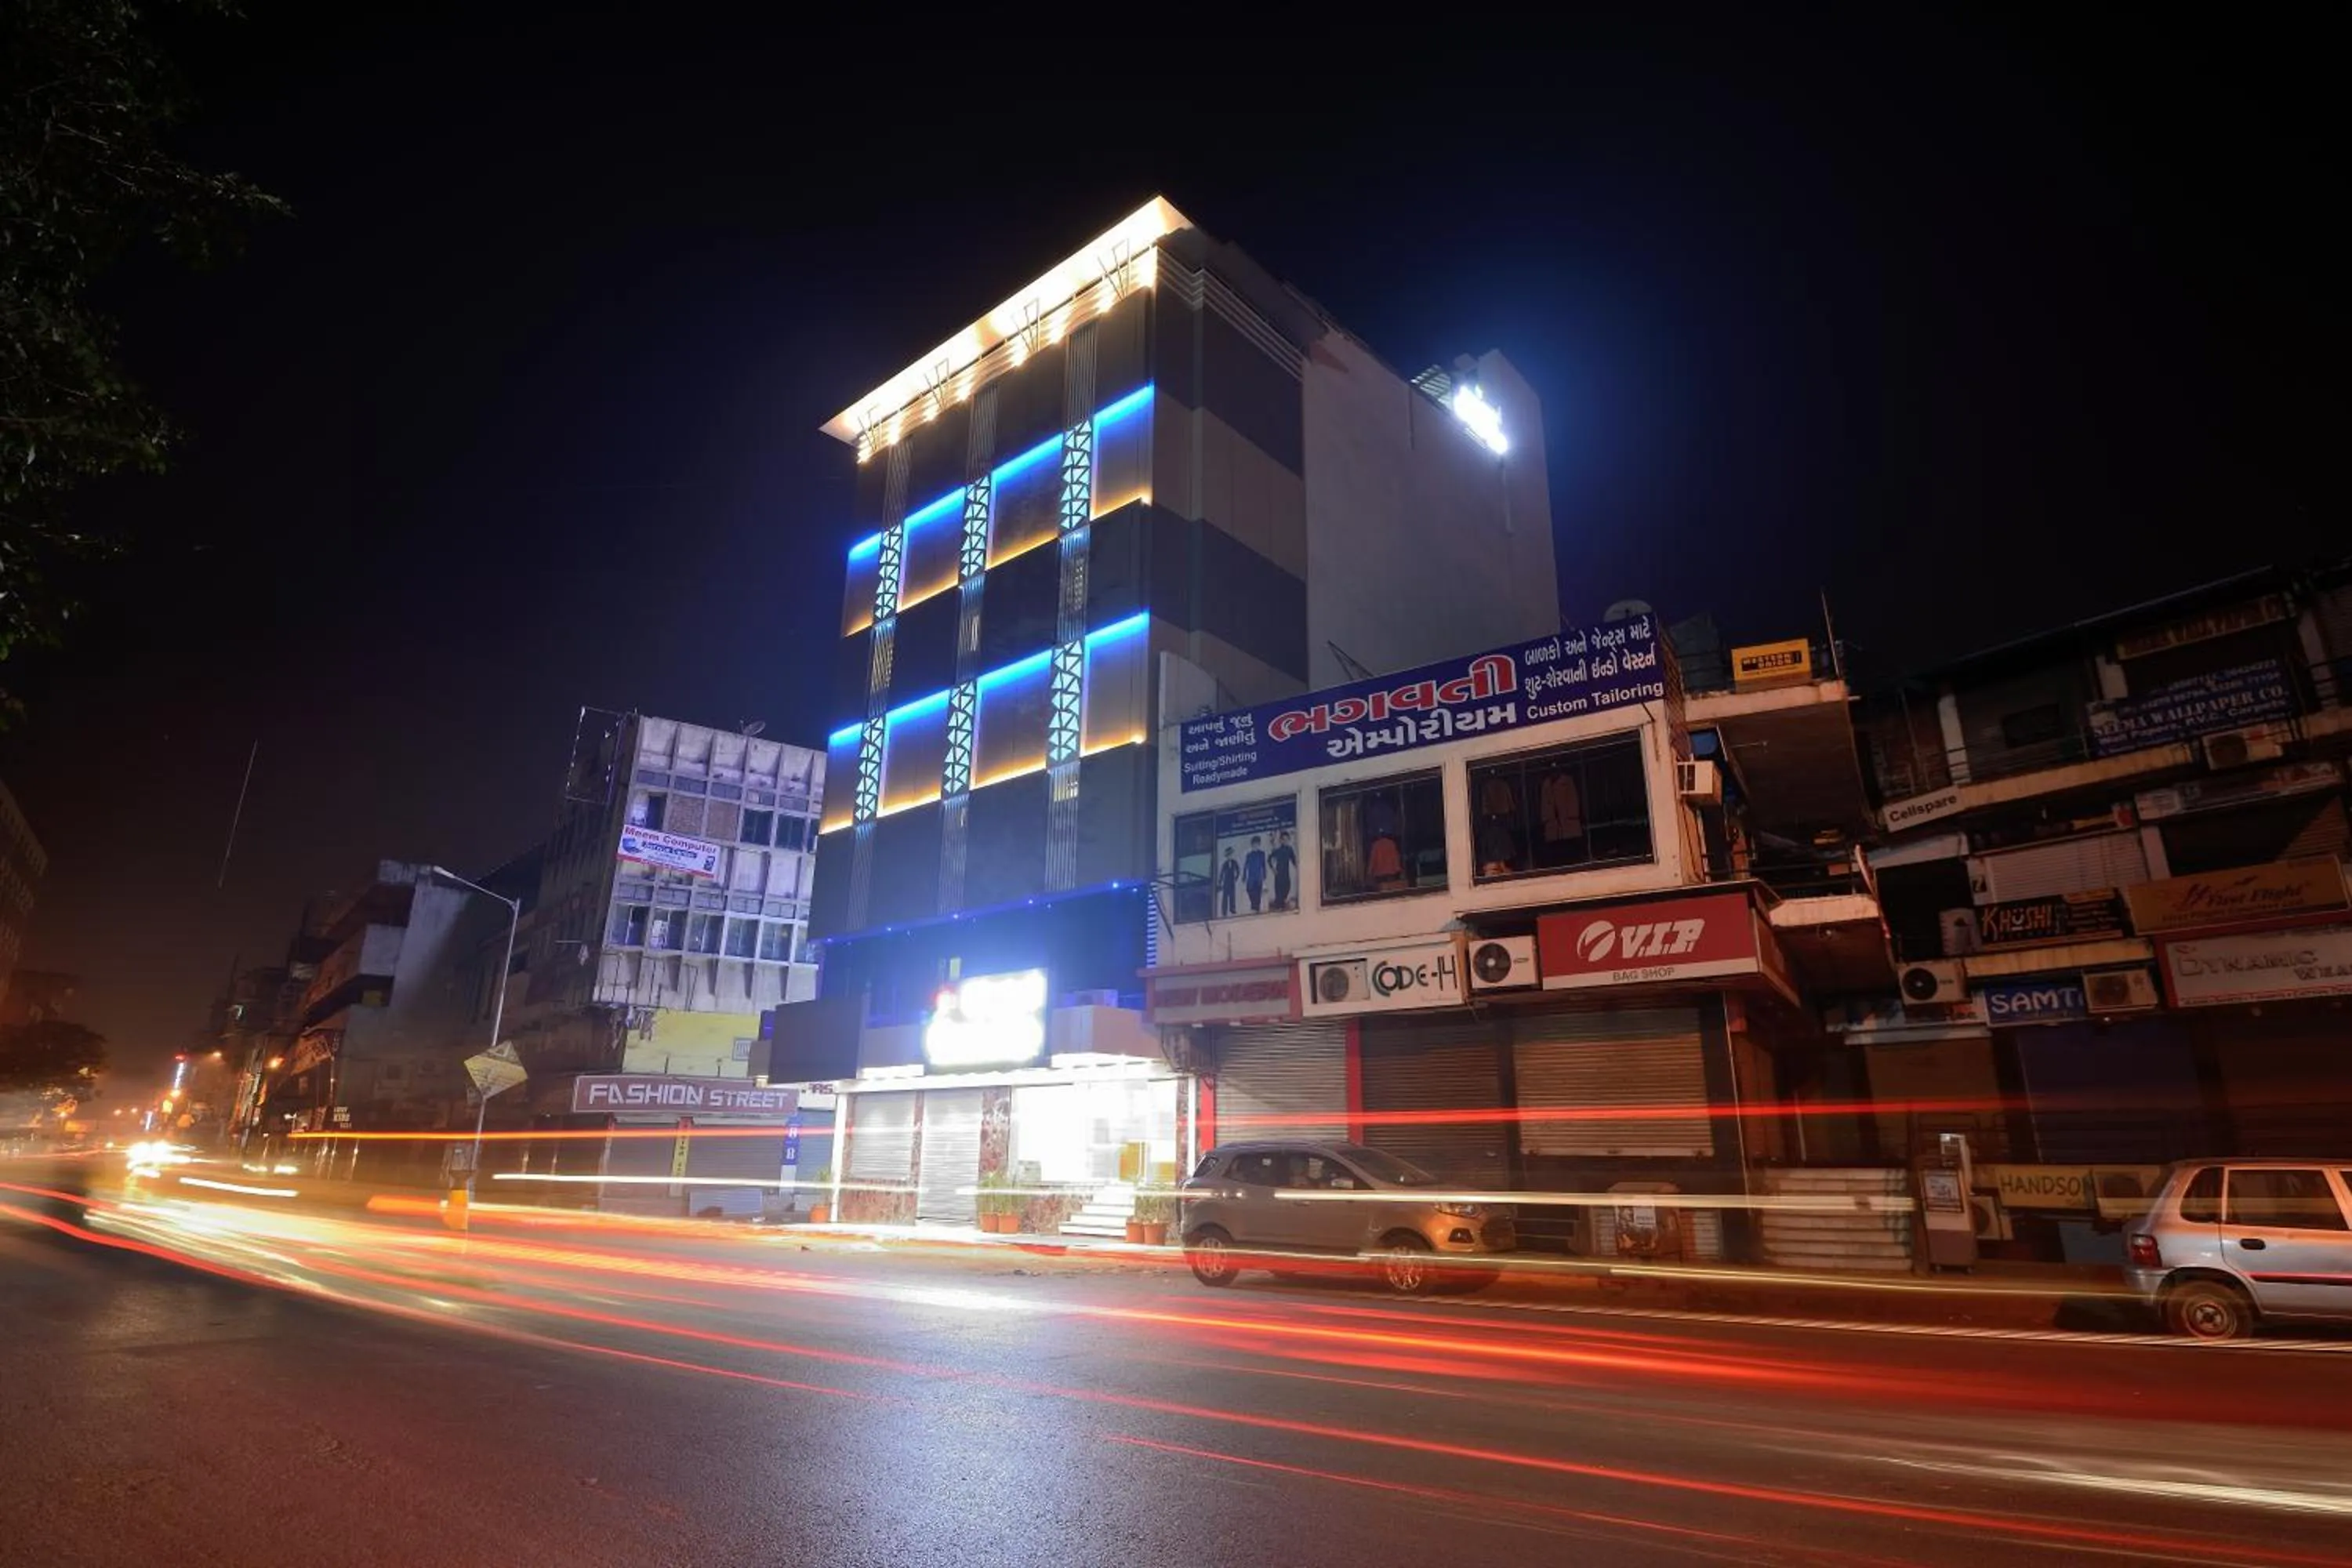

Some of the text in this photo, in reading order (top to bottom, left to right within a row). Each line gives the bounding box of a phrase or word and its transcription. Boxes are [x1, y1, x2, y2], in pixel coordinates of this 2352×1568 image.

[1565, 630, 1588, 655] અને
[1630, 615, 1651, 641] માટે
[1268, 654, 1518, 742] ભગવતી
[1526, 682, 1664, 720] Custom Tailoring
[2150, 690, 2255, 725] WALLPAPER
[1185, 738, 1210, 753] અને
[1192, 766, 1249, 786] Readymade
[1889, 795, 1957, 822] Cellspare
[624, 826, 659, 841] Meem
[662, 835, 717, 854] Computer
[1613, 966, 1675, 982] BAG SHOP
[2179, 949, 2319, 976] DYNAMIC
[2294, 964, 2352, 981] WEA
[588, 1083, 705, 1106] FASHION
[709, 1087, 789, 1109] STREET
[2000, 1173, 2084, 1196] HANDSO
